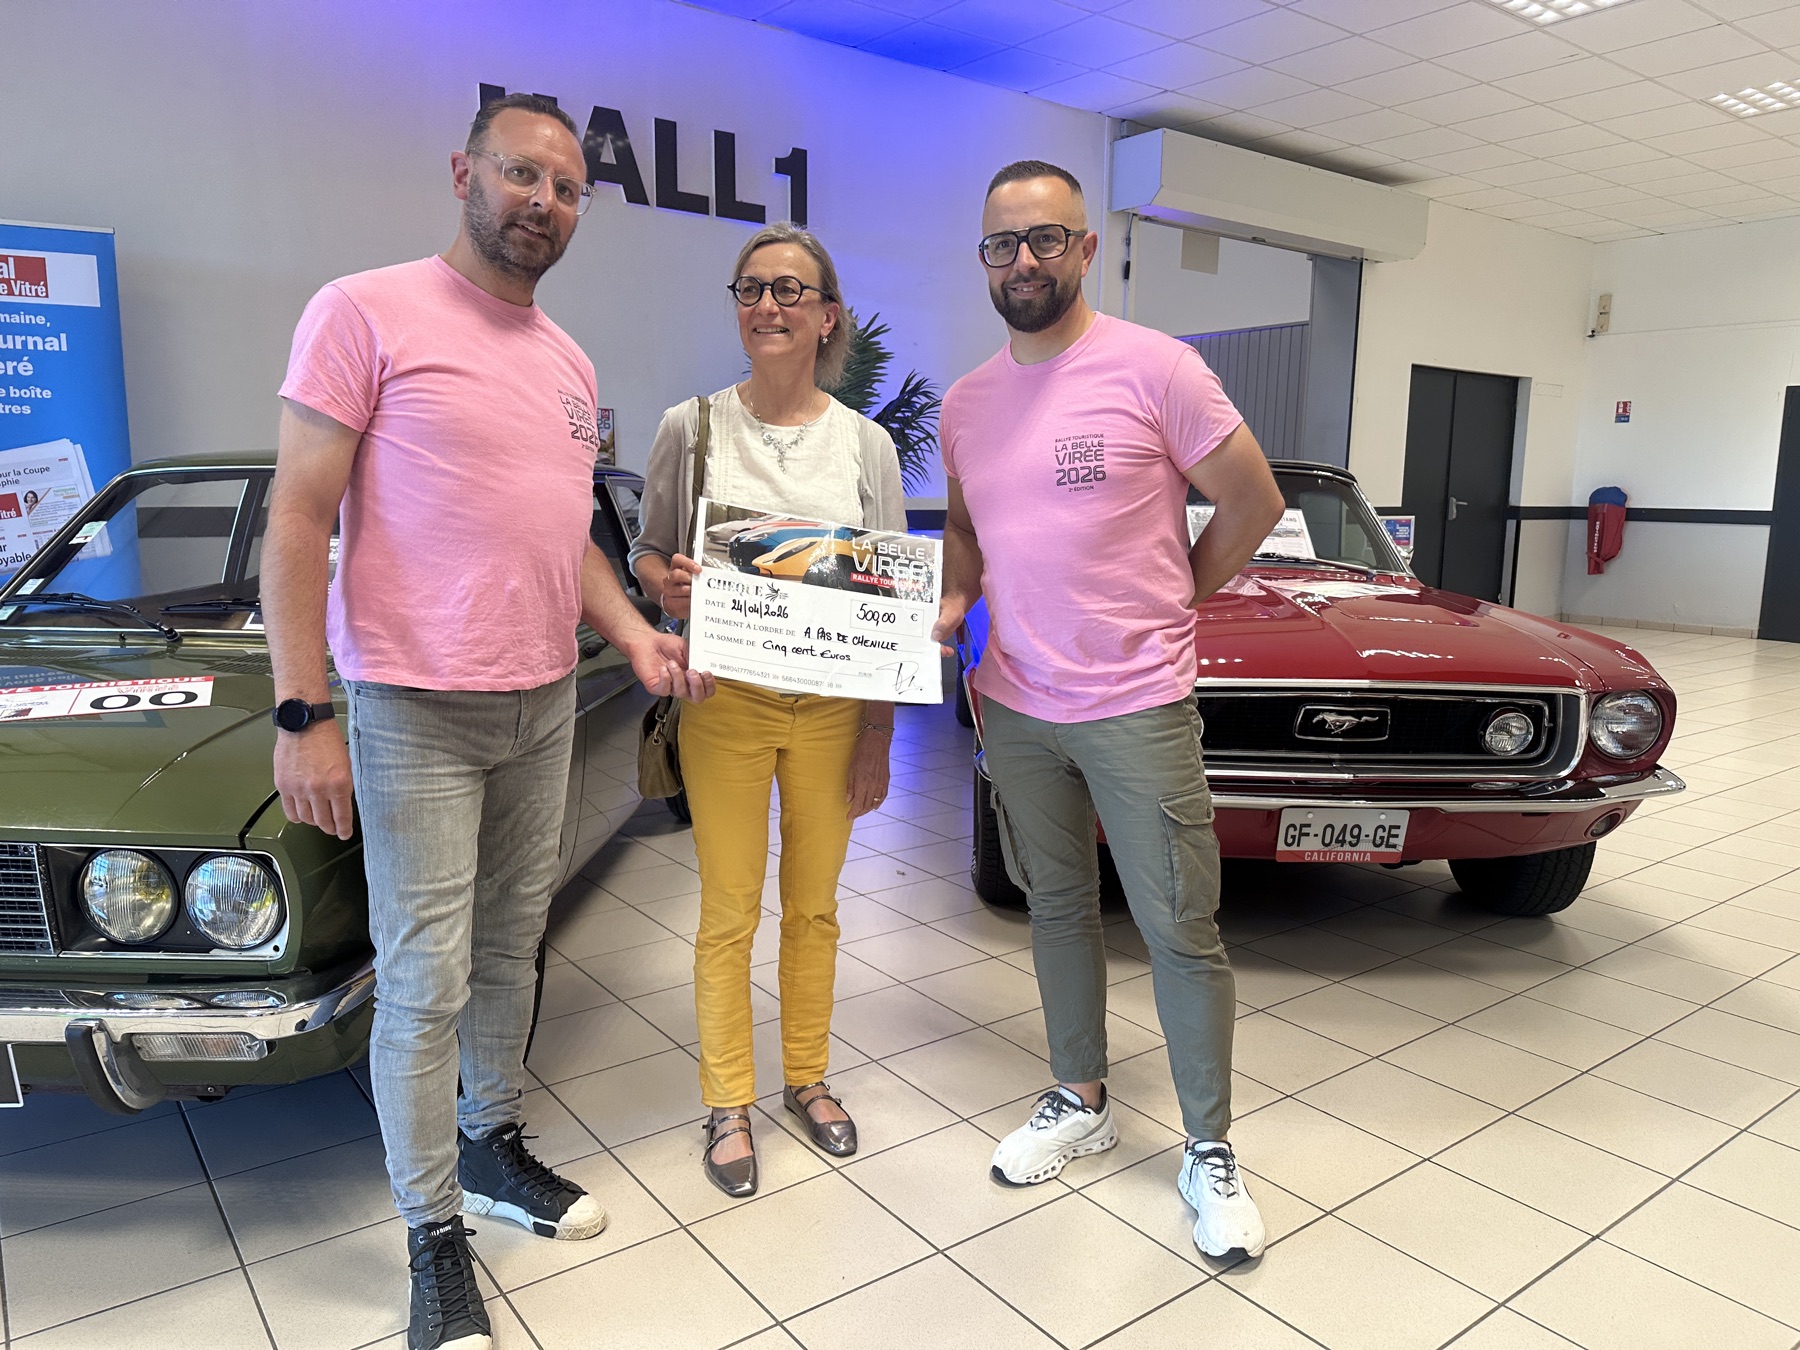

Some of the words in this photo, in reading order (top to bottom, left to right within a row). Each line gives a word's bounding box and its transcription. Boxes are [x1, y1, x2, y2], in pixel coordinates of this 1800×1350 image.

[479, 82, 766, 225] ALL
[773, 147, 807, 229] 1
[10, 280, 46, 297] Vitré
[0, 332, 67, 351] urnal
[9, 386, 52, 399] boîte
[1055, 443, 1069, 453] LA
[1071, 440, 1104, 450] BELLE
[1055, 447, 1105, 466] VIRÉE
[23, 466, 51, 475] Coupe
[1055, 465, 1107, 486] 2026
[0, 478, 20, 488] phie
[0, 508, 17, 519] itré
[851, 537, 873, 552] LA
[877, 541, 926, 559] BELLE
[852, 573, 879, 584] RALLYE
[705, 599, 726, 608] DATE
[856, 603, 896, 627] 500,00
[910, 613, 918, 622] €
[704, 615, 744, 628] PAIEMENT
[745, 621, 752, 630] À
[753, 624, 784, 635] L'ORDRE
[785, 629, 796, 637] DE
[804, 626, 811, 639] A
[816, 627, 832, 641] PAS
[852, 635, 899, 651] CHENILLE
[716, 634, 745, 645] SOMME
[746, 639, 757, 647] DE
[762, 639, 787, 657] Cinq
[791, 645, 817, 657] cent
[40, 676, 206, 691] TOURISTIQUE
[90, 690, 198, 710] 00
[1284, 823, 1401, 849] GF-049-GE
[1304, 851, 1371, 862] CALIFORNIA
